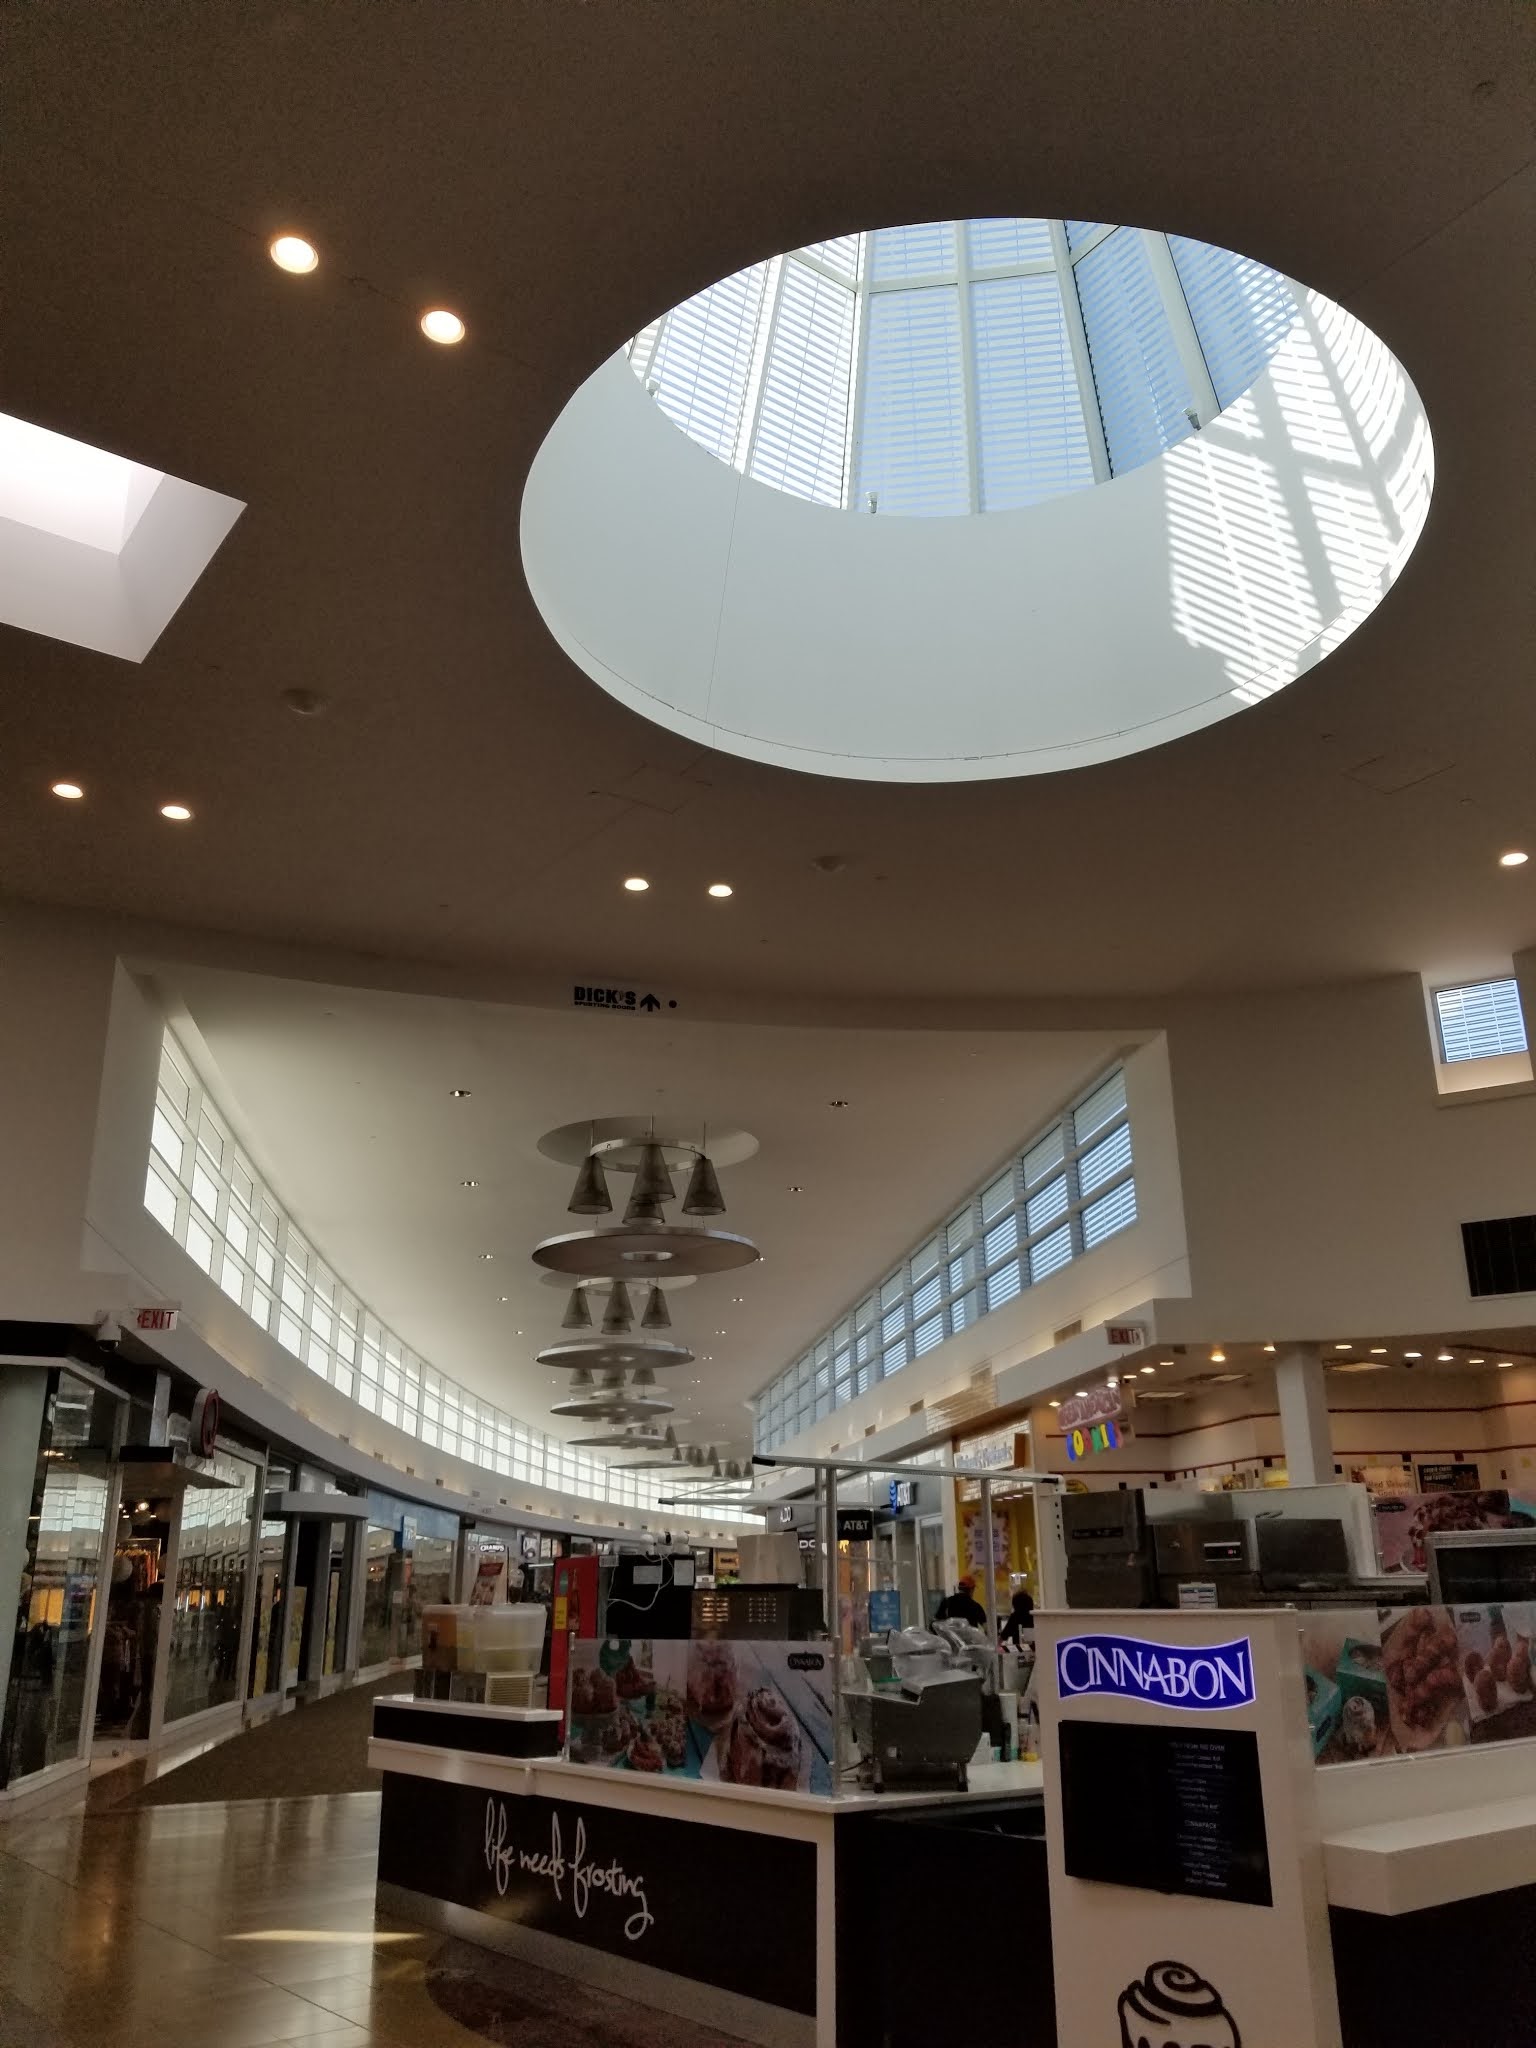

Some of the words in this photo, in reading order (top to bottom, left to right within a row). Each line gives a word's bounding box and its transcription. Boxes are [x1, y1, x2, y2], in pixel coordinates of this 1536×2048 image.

[574, 986, 636, 1005] DICK'S
[141, 1310, 175, 1329] EXIT
[1110, 1328, 1135, 1344] EXIT
[843, 1520, 869, 1531] AT&T
[1060, 1642, 1247, 1700] CINNABON
[519, 1810, 565, 1902] needs
[567, 1816, 655, 1941] frosting
